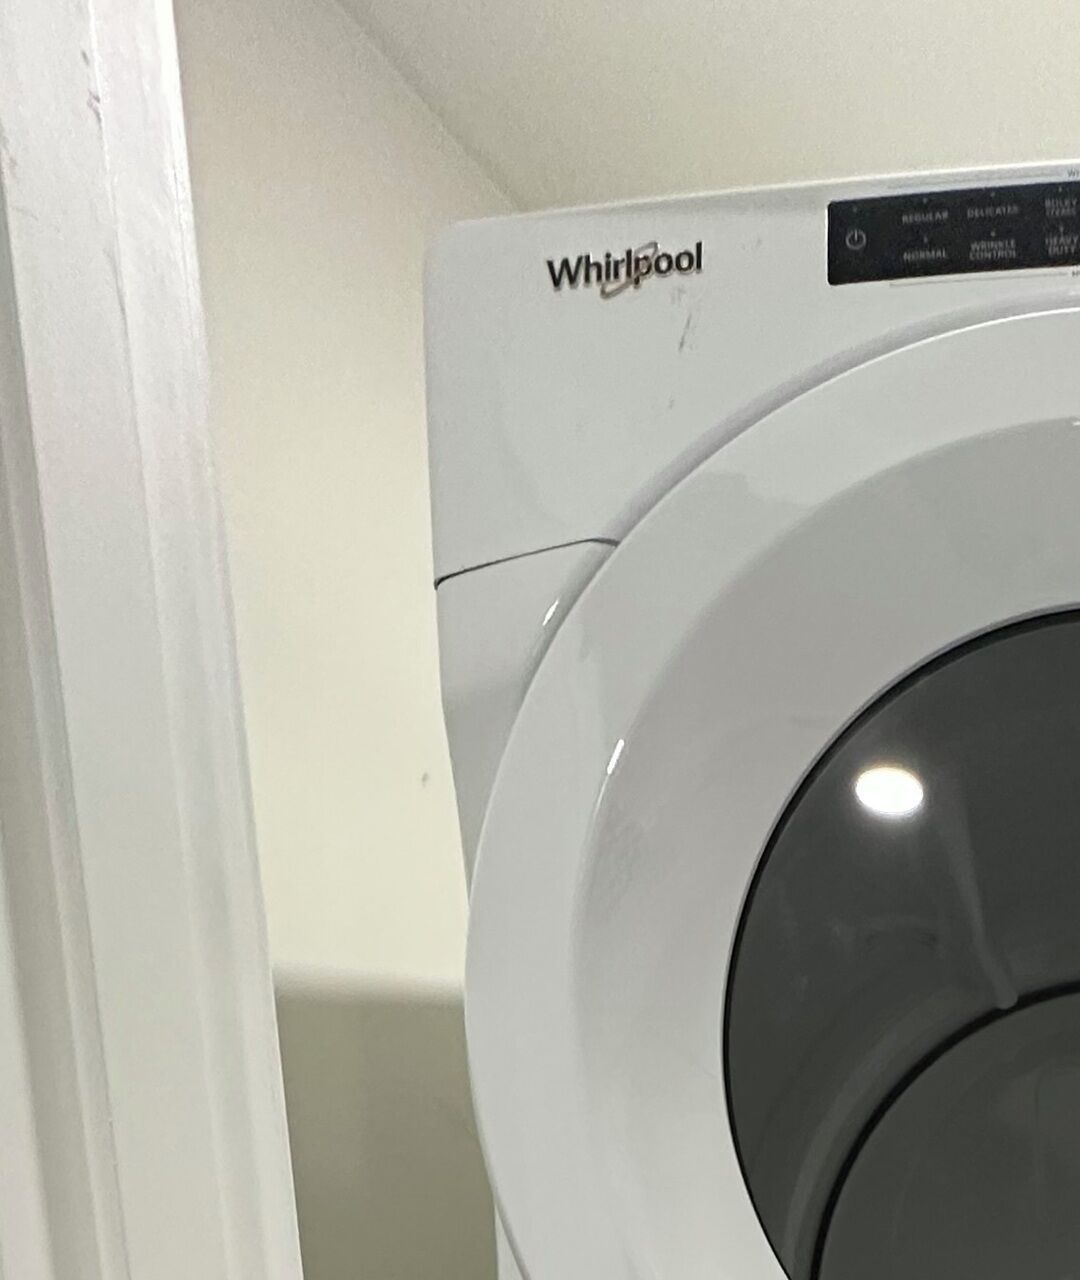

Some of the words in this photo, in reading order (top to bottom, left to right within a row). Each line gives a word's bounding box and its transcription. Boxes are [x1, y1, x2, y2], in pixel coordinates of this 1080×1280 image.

[902, 210, 948, 224] REGULAR
[904, 248, 948, 261] NORMAL
[546, 240, 703, 297] Whirlpool
